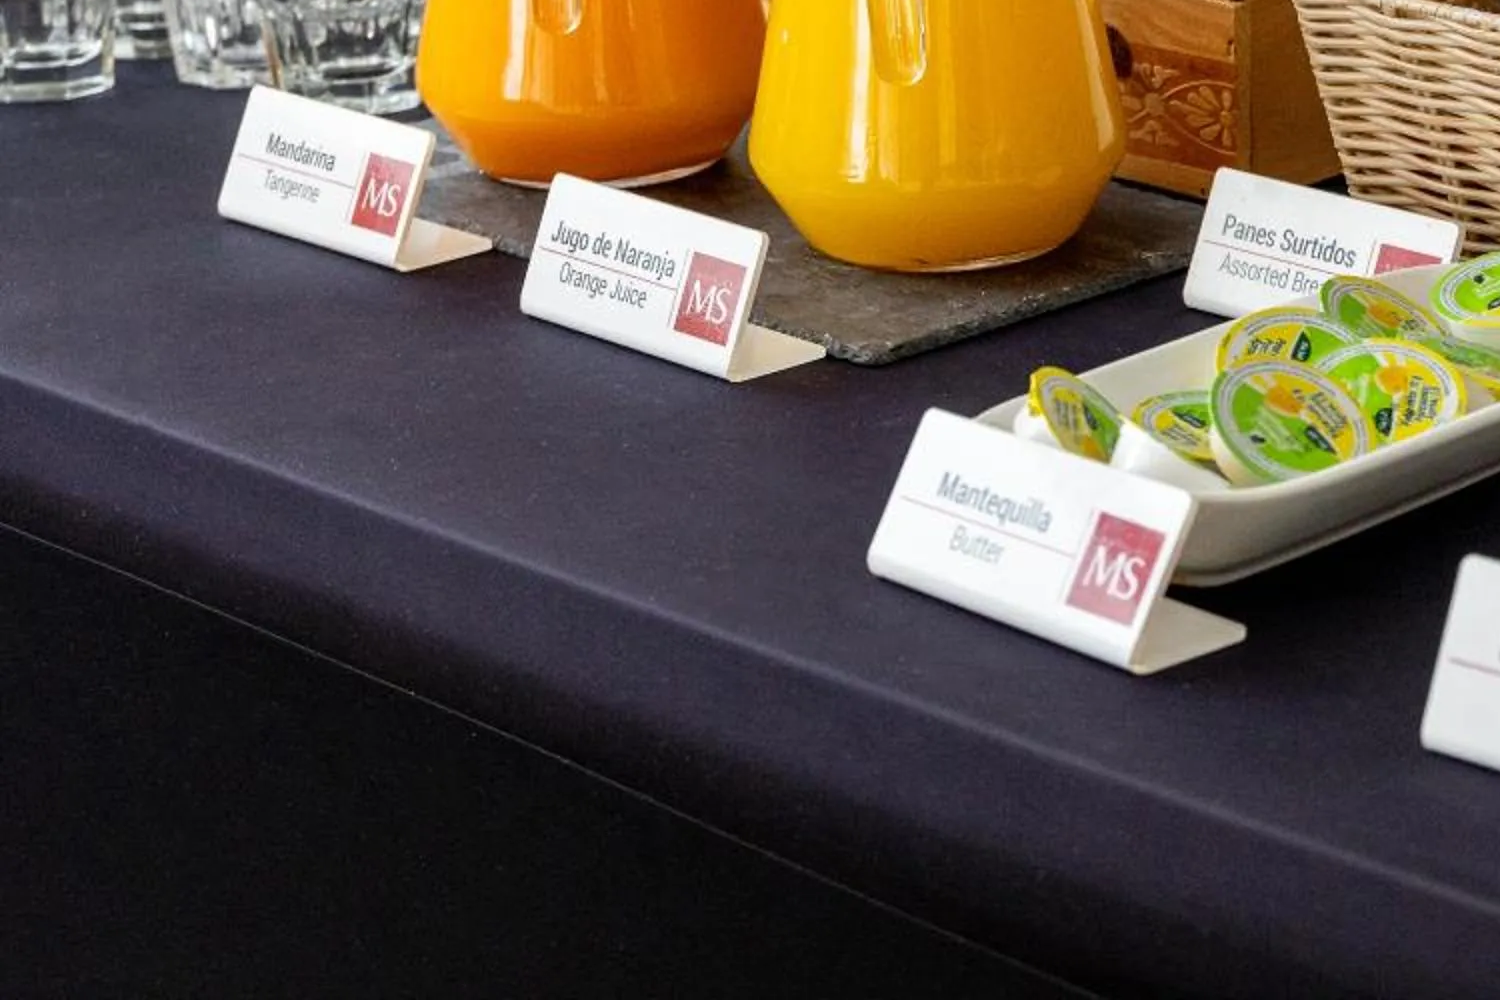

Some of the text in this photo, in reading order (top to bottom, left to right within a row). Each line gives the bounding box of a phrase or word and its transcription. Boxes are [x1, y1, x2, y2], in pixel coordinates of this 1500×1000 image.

[265, 132, 336, 172] Mandarina
[263, 168, 321, 203] Tangerine
[361, 177, 402, 217] MS
[551, 220, 677, 281] Jugo de Naranja
[1221, 213, 1357, 268] Panes Surtidos
[559, 262, 648, 309] Orange Juice
[1217, 251, 1321, 295] Assorted Bre
[686, 280, 731, 325] MS
[936, 471, 1053, 535] Mantequilla
[949, 525, 1005, 565] Butter
[1082, 545, 1146, 600] MS
